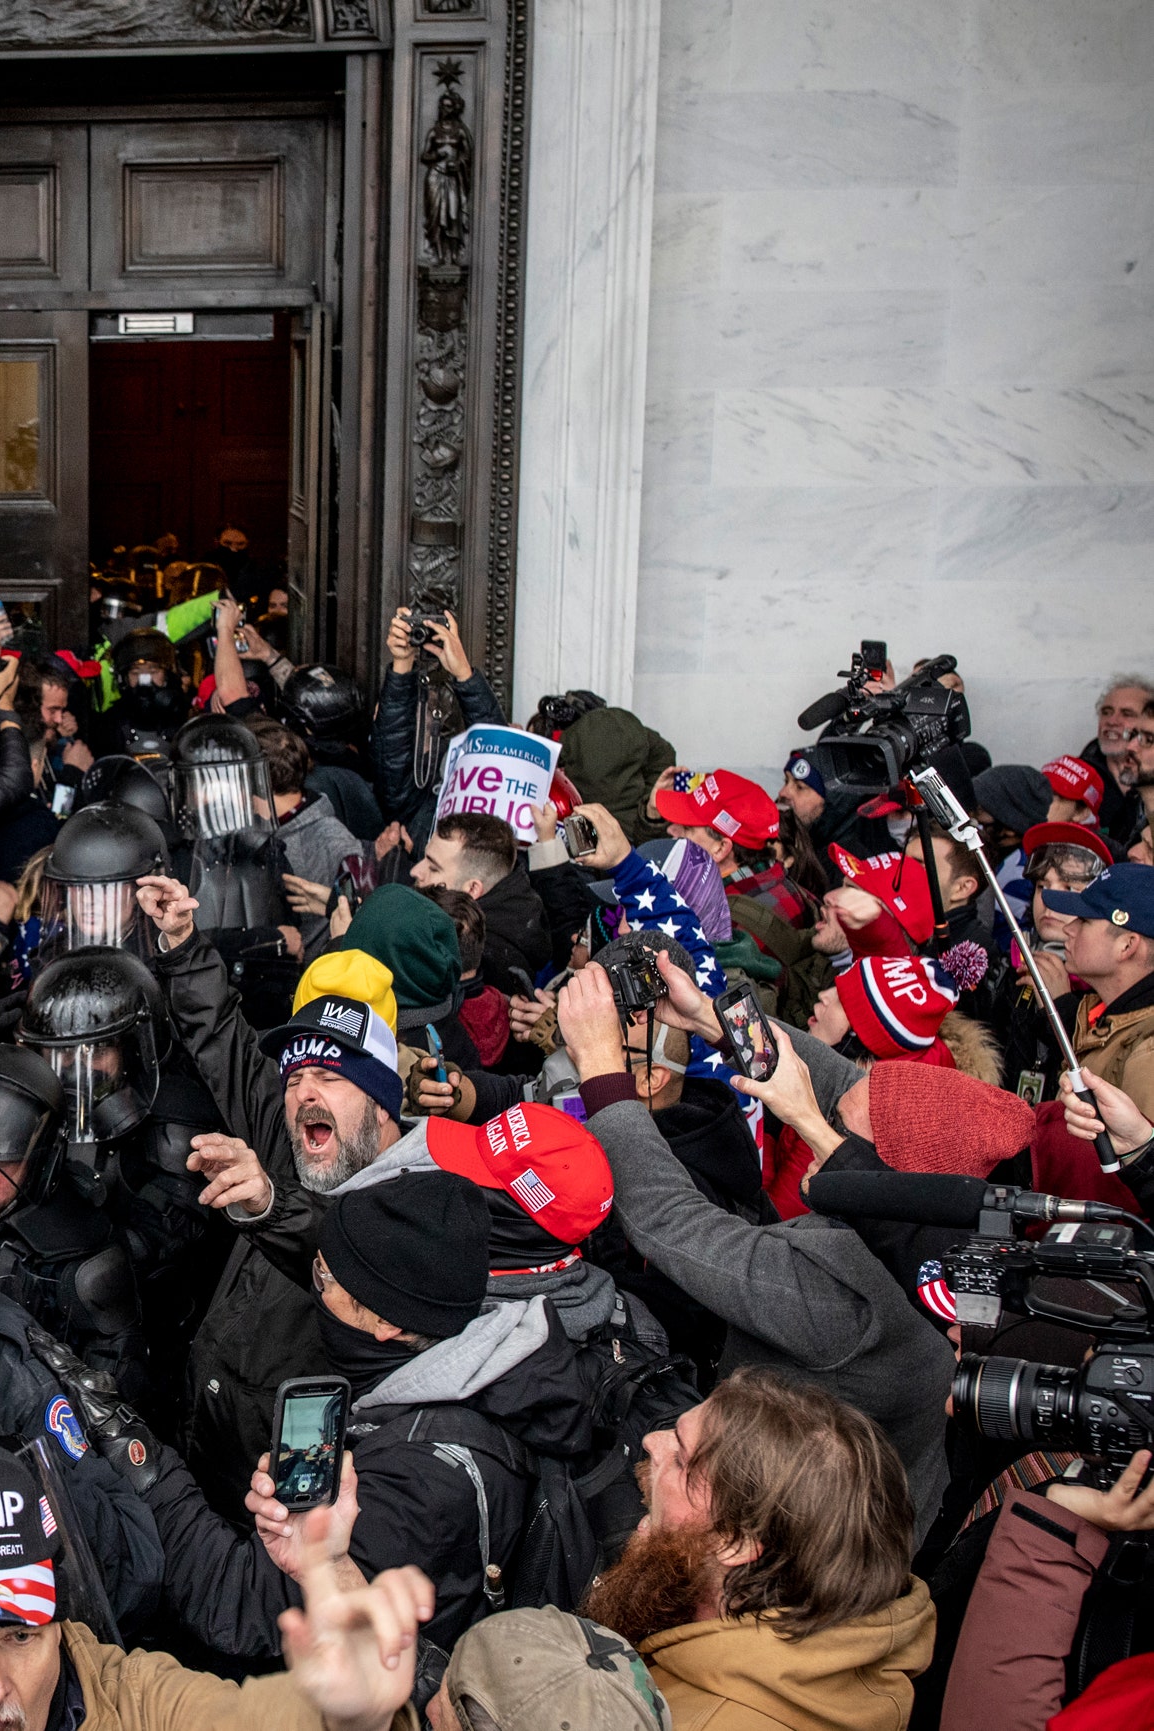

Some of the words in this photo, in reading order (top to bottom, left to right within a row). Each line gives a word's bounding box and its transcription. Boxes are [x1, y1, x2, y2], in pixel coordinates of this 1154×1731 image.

[481, 743, 500, 754] FOR
[502, 748, 545, 768] AMERICA
[446, 766, 503, 796] ave
[505, 778, 538, 799] THE
[506, 1102, 532, 1152] MERICA
